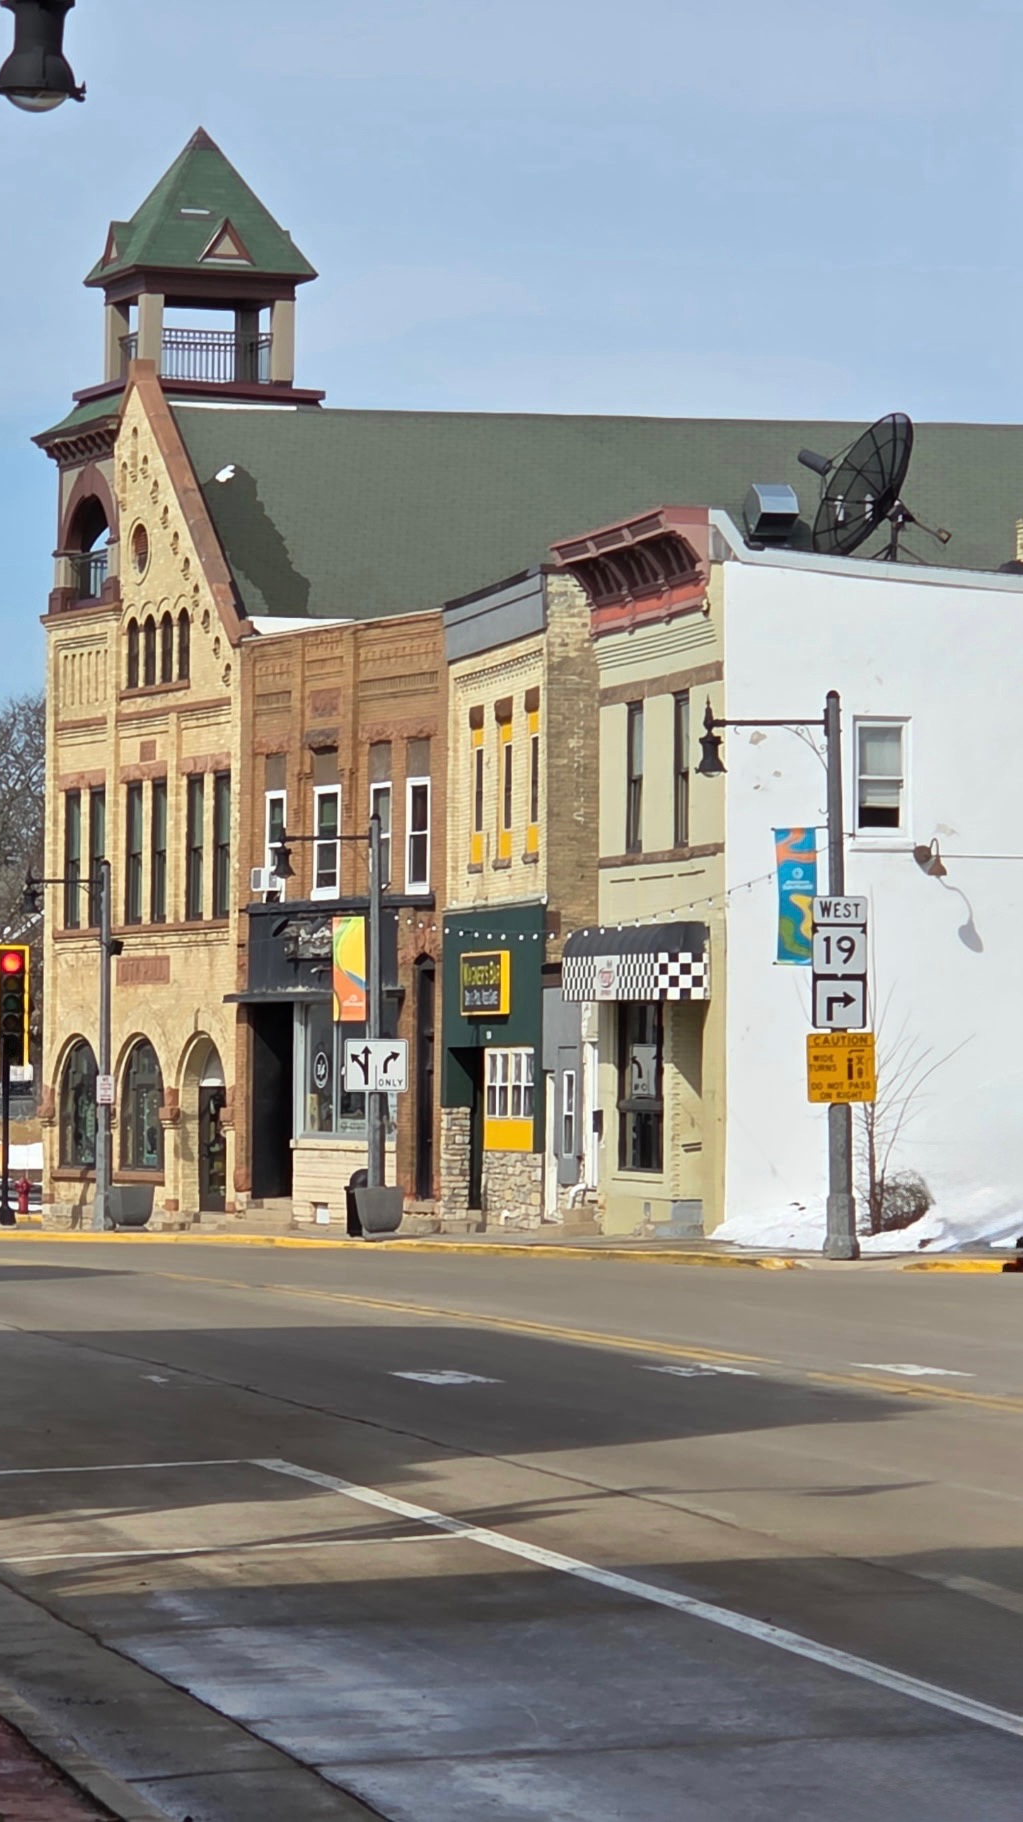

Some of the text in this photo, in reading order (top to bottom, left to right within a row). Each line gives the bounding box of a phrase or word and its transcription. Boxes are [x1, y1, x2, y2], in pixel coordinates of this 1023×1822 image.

[819, 900, 861, 919] WEST
[823, 935, 856, 965] 19
[813, 1035, 868, 1047] CAUTION
[812, 1054, 834, 1062] WIDE
[809, 1063, 837, 1072] TURNS
[378, 1078, 404, 1087] ONLY
[810, 1080, 871, 1090] DO NOT PASS
[819, 1091, 863, 1100] ON RIGHT
